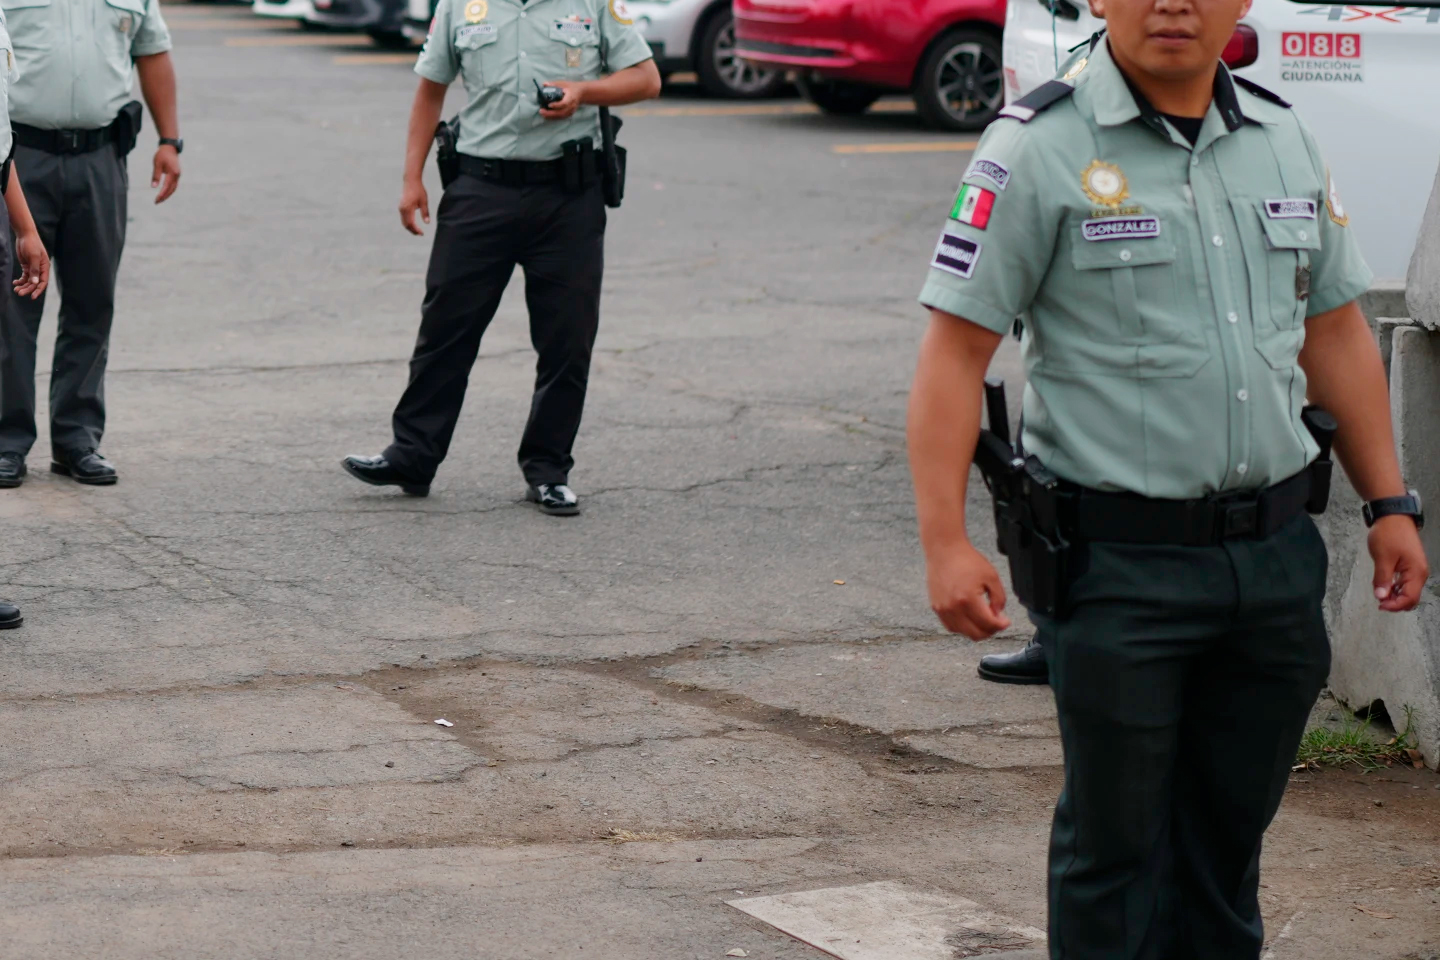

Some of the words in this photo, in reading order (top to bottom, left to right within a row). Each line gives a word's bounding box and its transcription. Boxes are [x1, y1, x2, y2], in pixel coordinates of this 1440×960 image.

[1284, 34, 1357, 57] 088
[1291, 59, 1352, 71] ATENCIÓN
[1281, 71, 1363, 82] CIUDADANA
[974, 161, 1006, 182] EXICO
[1086, 221, 1157, 236] GONZALEZ
